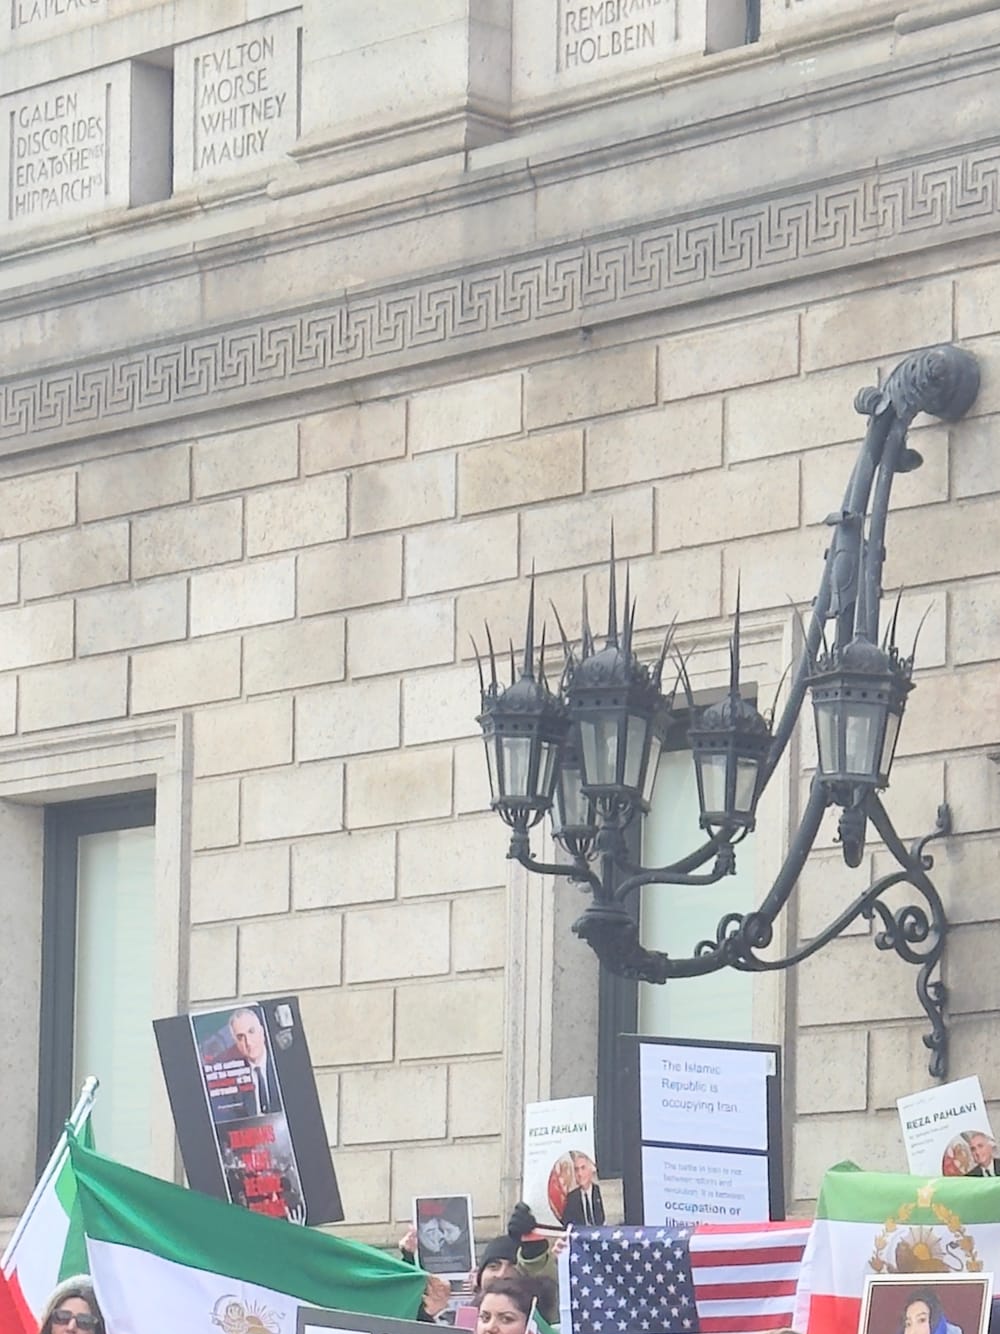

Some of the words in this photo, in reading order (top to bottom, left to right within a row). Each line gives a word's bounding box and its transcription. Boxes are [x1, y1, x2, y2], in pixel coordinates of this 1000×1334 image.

[565, 0, 669, 35] REMBR
[565, 21, 655, 68] HOLBEIN
[201, 67, 268, 108] MORSE
[19, 92, 77, 128] GALEN
[201, 92, 286, 135] WHITNEY
[201, 129, 268, 168] MAURY
[661, 1060, 681, 1072] The
[661, 1078, 707, 1093] Republic
[551, 1124, 588, 1135] PAHLAVI
[906, 1116, 931, 1130] REZA
[933, 1102, 977, 1122] PAHLAVI
[665, 1201, 726, 1215] occupation
[730, 1207, 741, 1216] or
